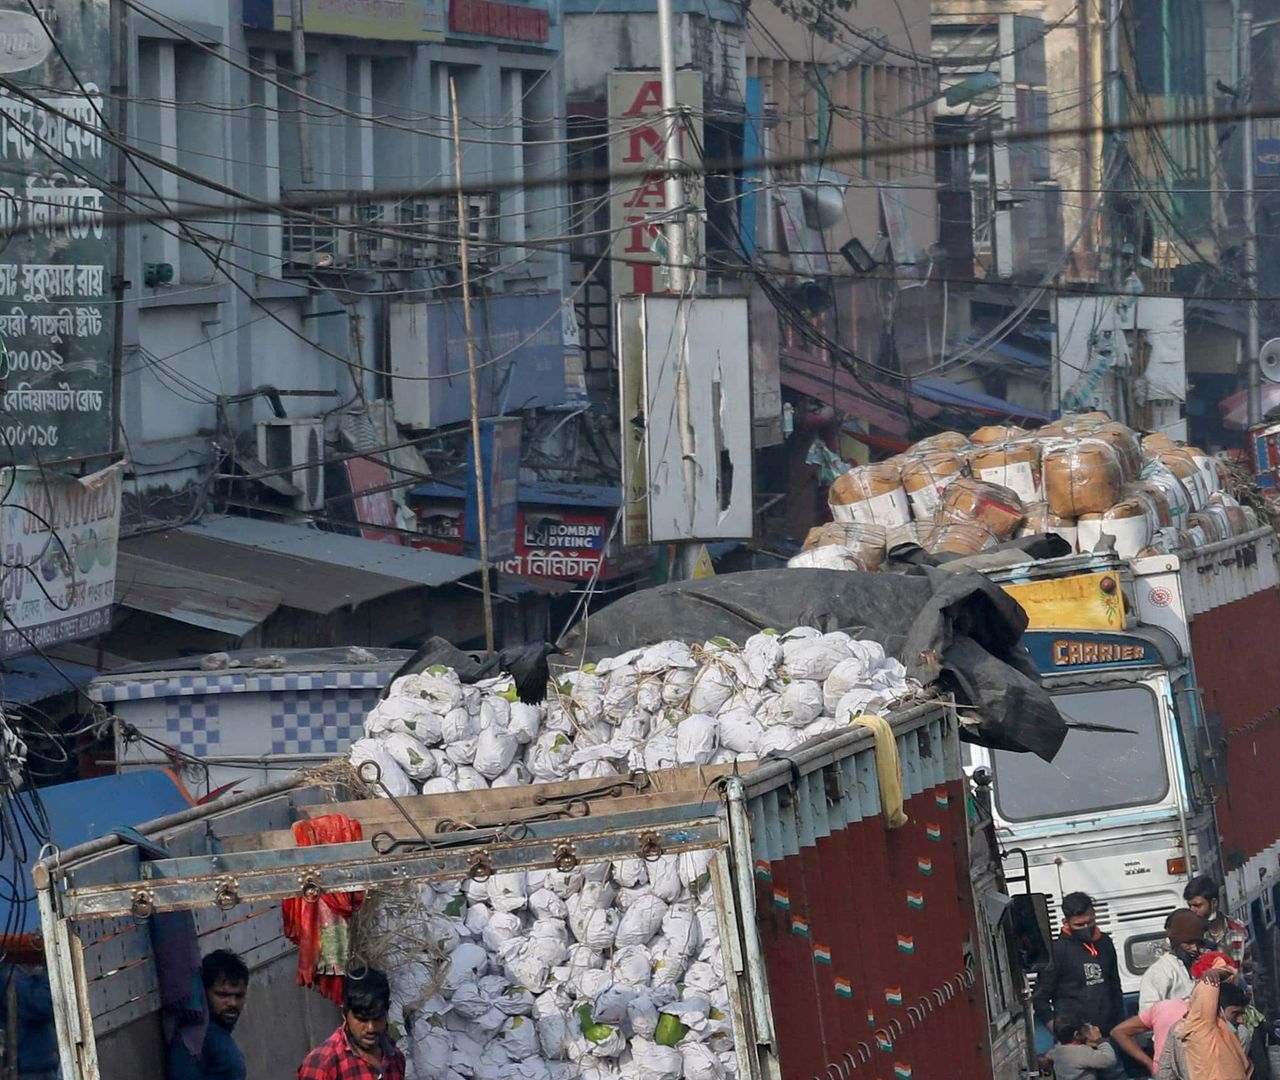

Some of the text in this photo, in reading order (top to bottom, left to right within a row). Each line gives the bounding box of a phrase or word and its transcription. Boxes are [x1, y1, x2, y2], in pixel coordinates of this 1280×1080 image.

[22, 264, 75, 303] সুকুমার
[77, 264, 104, 297] রায়
[30, 307, 74, 344] গাঙ্গুলী
[76, 389, 103, 413] রোড
[550, 525, 601, 538] BOMBAY
[550, 536, 593, 548] DYEING
[1053, 639, 1146, 666] CARRIER
